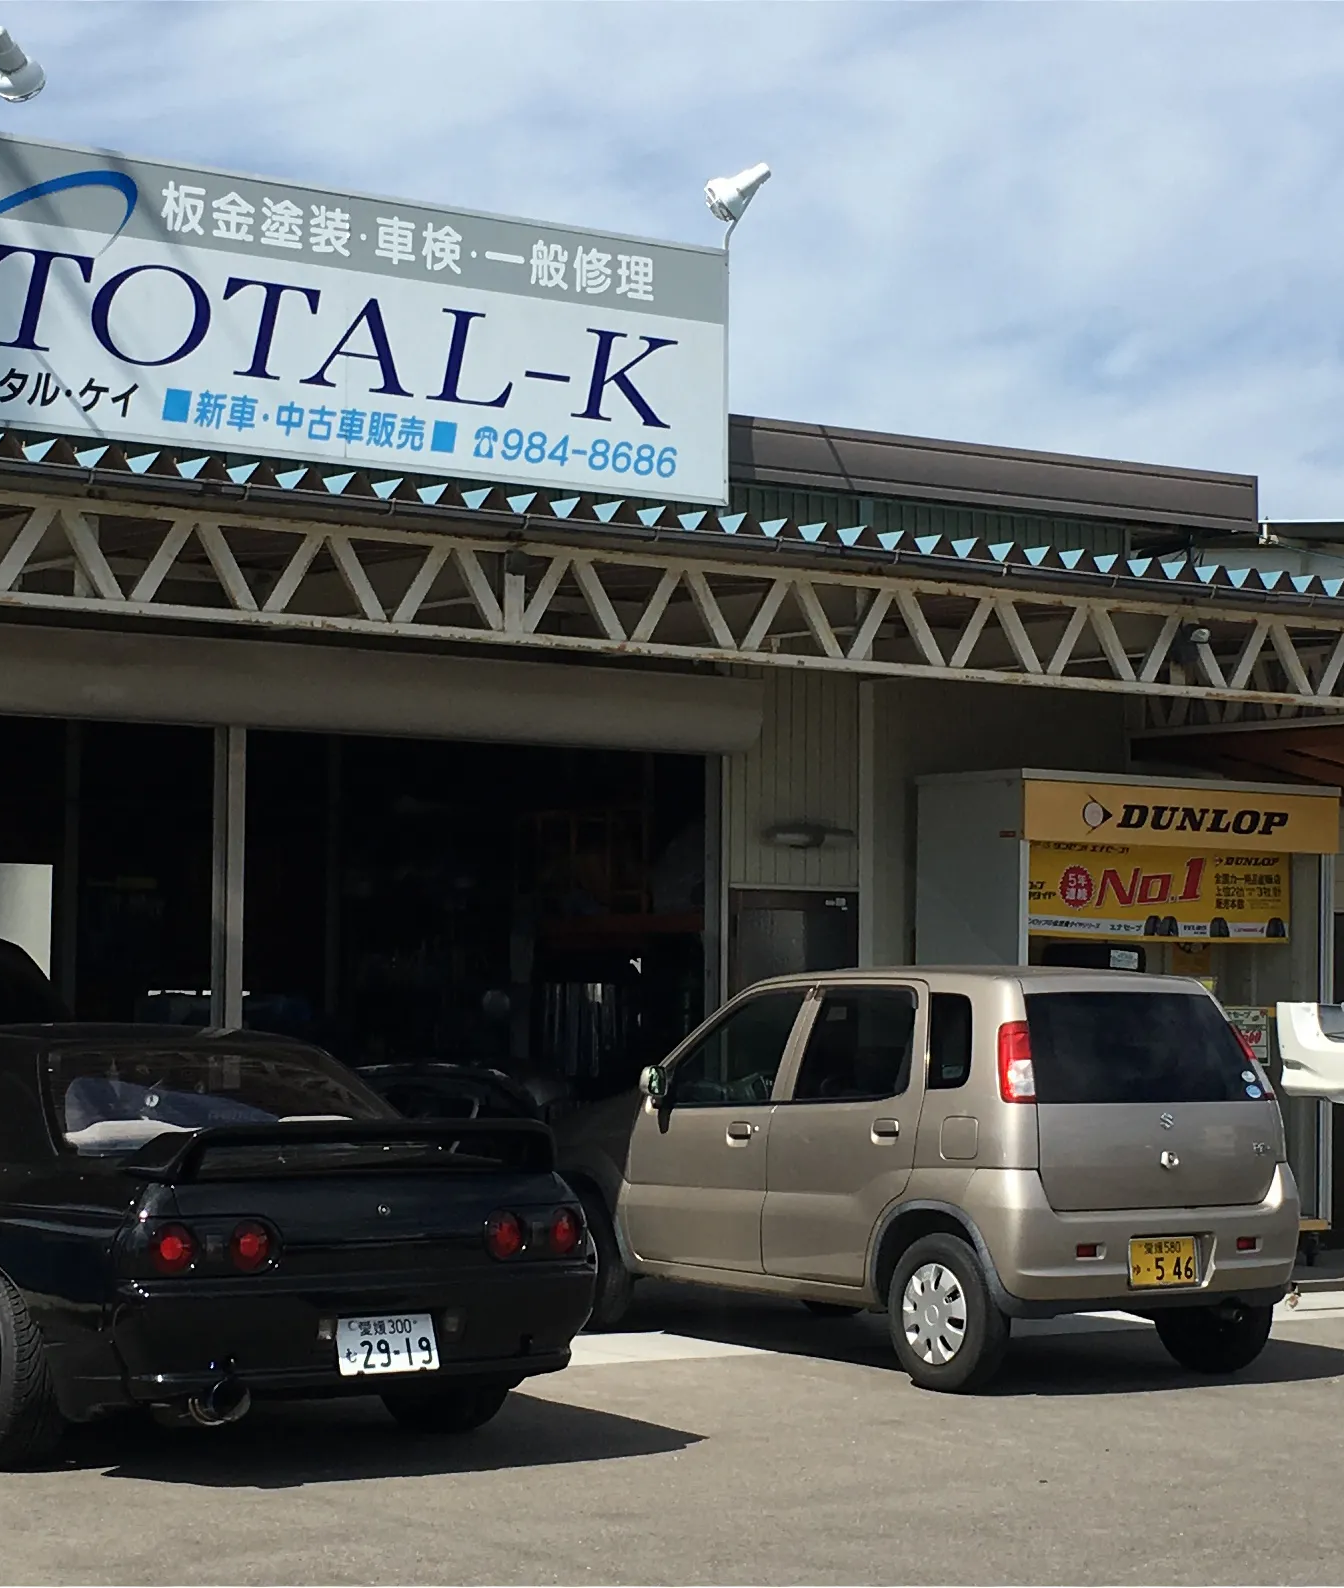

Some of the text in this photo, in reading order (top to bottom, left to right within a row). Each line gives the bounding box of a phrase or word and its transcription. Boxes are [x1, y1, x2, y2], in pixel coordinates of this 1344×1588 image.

[501, 426, 678, 478] 984-8686
[1117, 804, 1289, 836] DUNLOP
[1224, 856, 1280, 867] DUNLOP
[1095, 856, 1208, 909] No.1
[359, 1336, 433, 1369] 29-19
